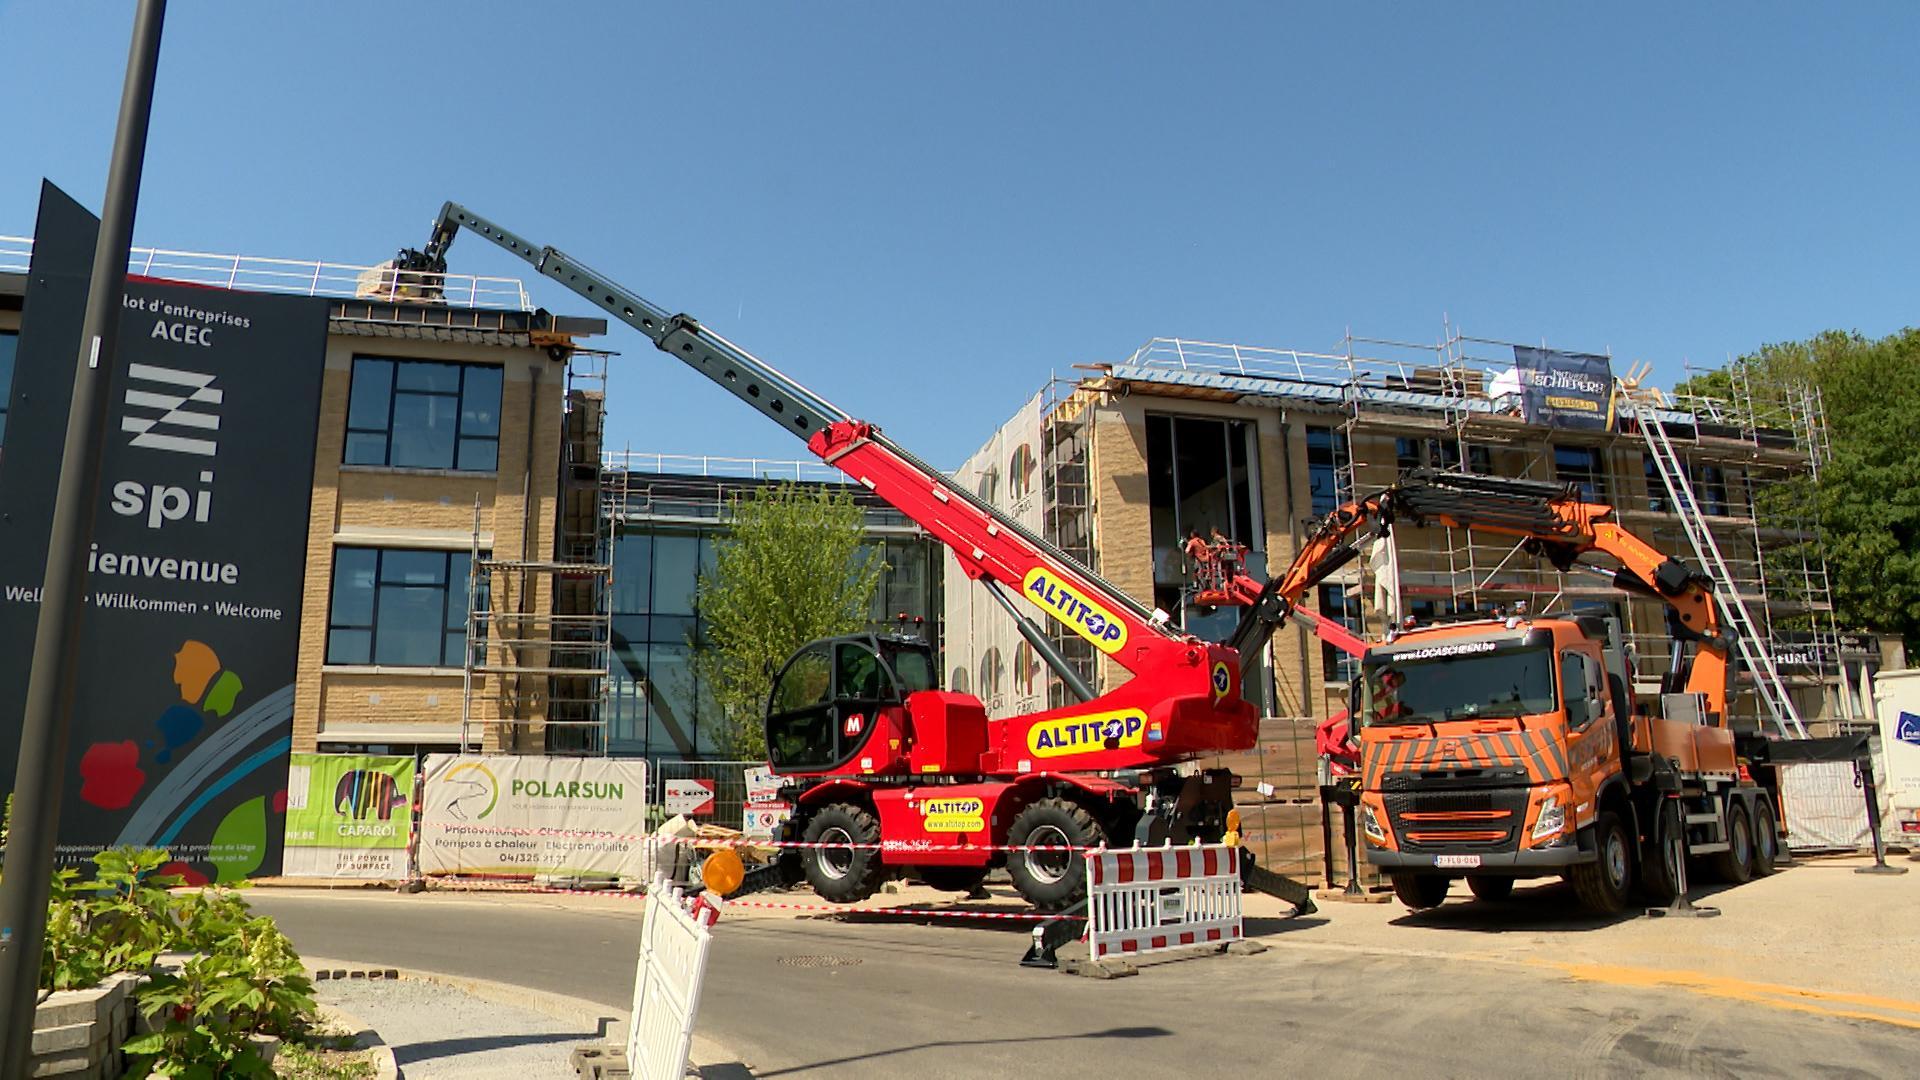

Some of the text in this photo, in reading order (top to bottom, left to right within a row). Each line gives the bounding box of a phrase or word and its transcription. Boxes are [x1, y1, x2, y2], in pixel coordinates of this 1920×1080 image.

[123, 293, 250, 328] lot d'entreprises
[151, 320, 213, 347] ACEC
[110, 471, 213, 528] spi
[88, 543, 239, 584] ienvenue
[5, 585, 282, 620] Wel Willkommen Welcome
[1029, 576, 1121, 643] ALTITOP
[1036, 716, 1141, 750] ALTITOP
[512, 779, 623, 799] POLARSUN
[929, 802, 979, 813] ALTITOP
[338, 824, 397, 837] CAPAROL
[927, 819, 981, 829] www.altitop.com
[435, 839, 537, 850] Pompes à chaleur
